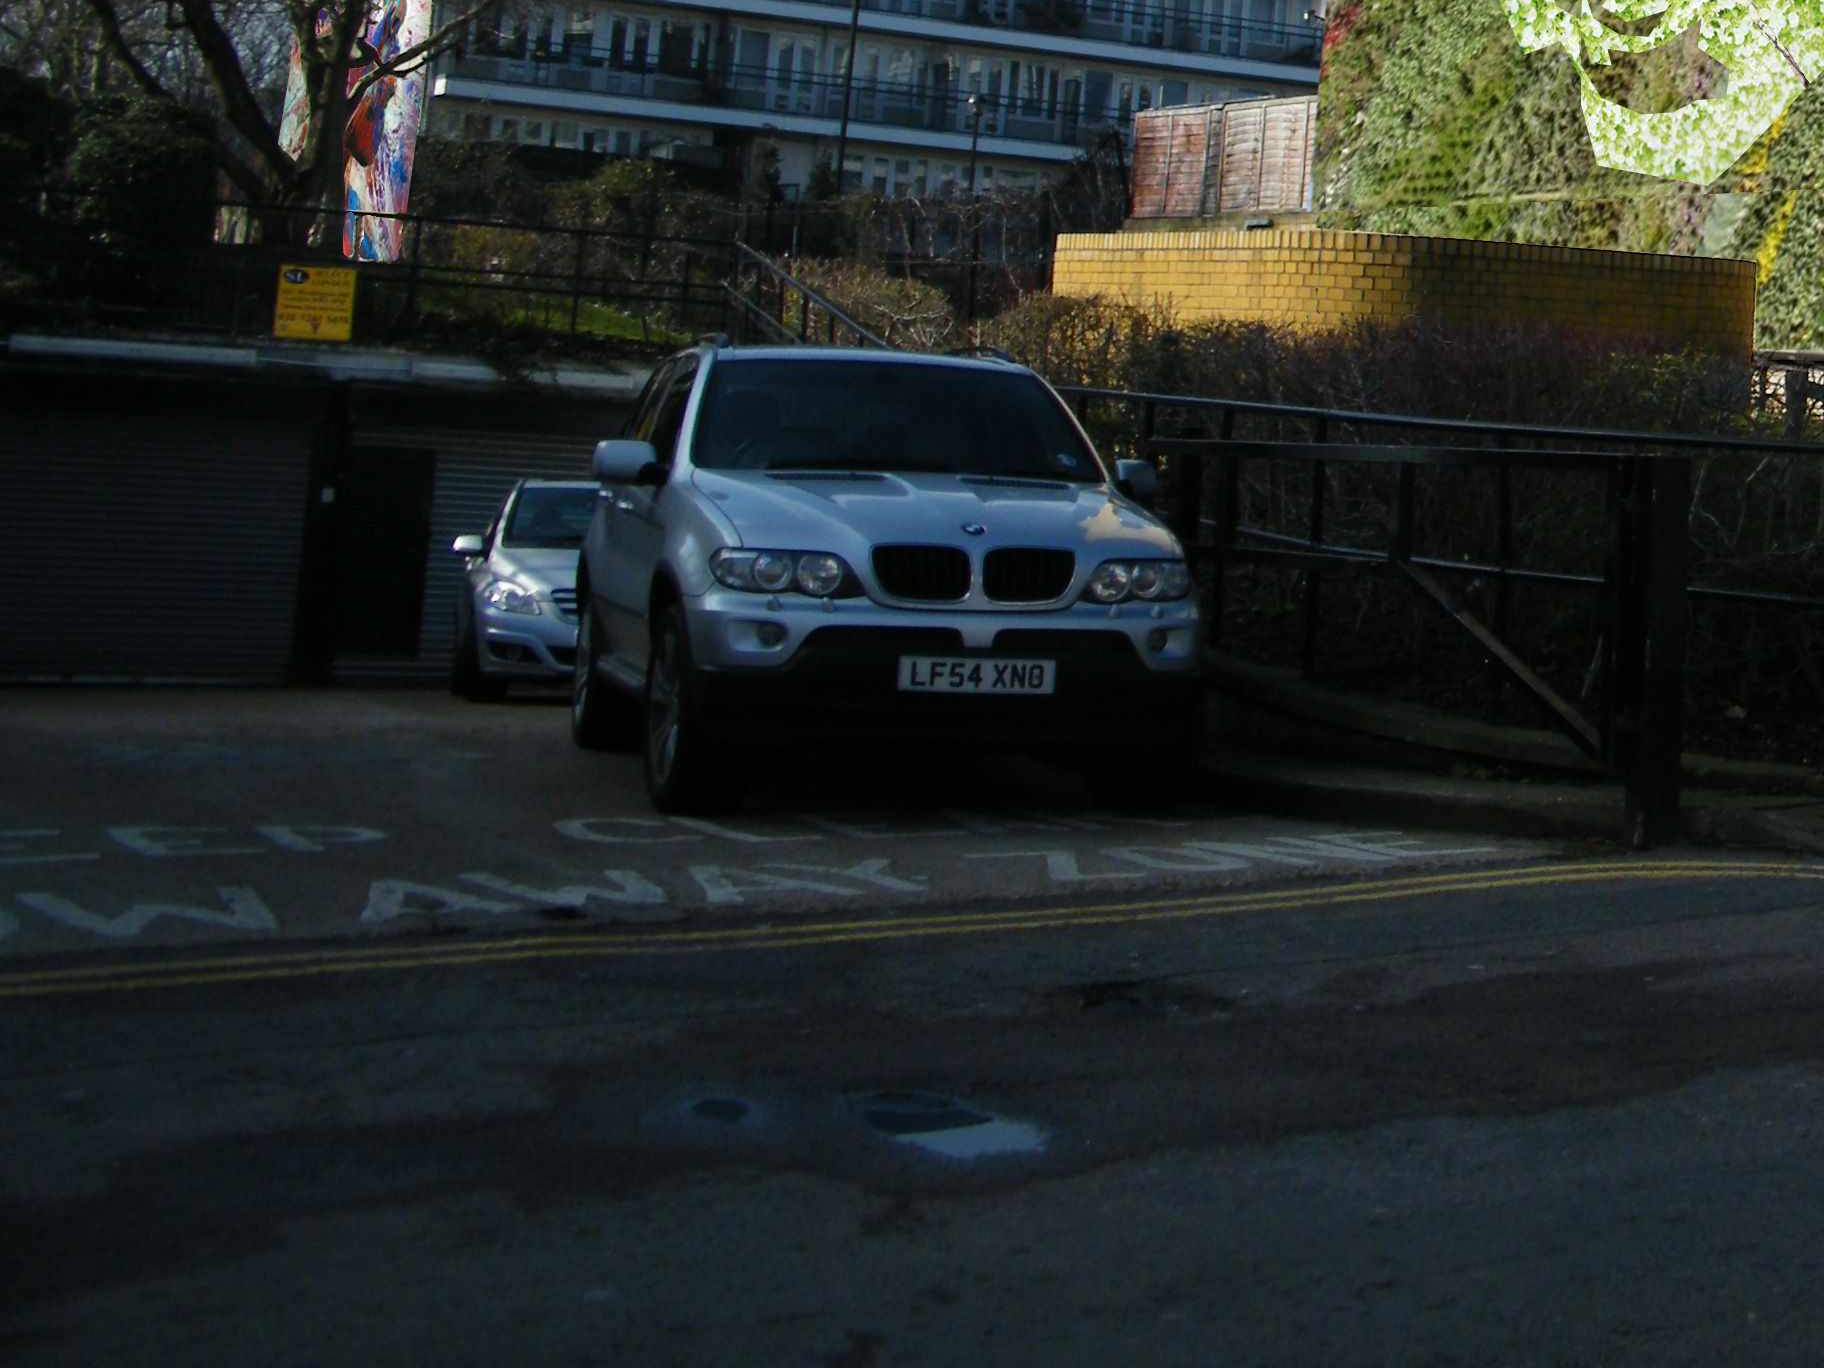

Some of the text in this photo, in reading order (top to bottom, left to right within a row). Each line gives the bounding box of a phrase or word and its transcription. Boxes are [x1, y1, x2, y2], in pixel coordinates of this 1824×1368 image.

[910, 661, 983, 689] LF54
[360, 858, 930, 924] AWAY
[962, 830, 1499, 882] ZONE
